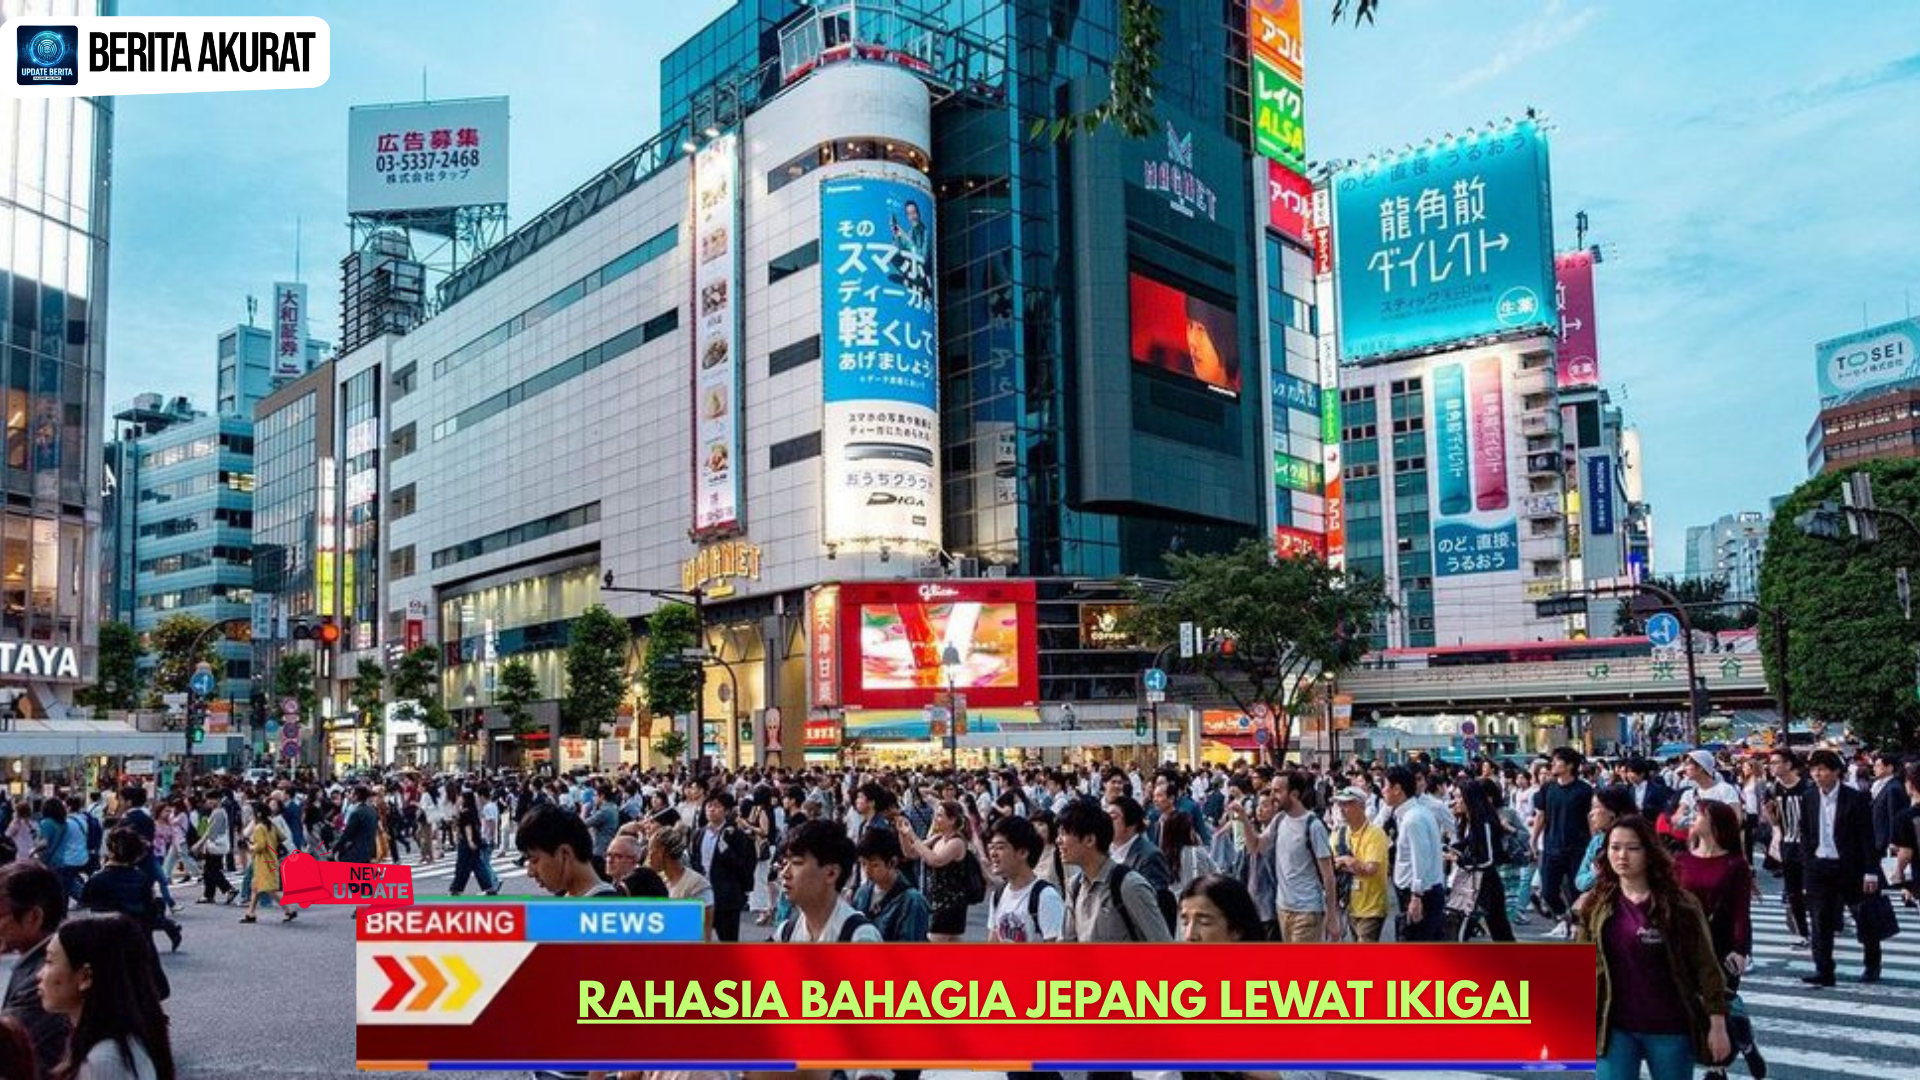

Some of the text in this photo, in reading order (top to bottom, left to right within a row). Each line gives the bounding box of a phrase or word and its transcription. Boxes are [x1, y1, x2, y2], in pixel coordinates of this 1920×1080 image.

[1258, 70, 1300, 119] レイク
[1258, 106, 1302, 149] ALSA
[378, 128, 480, 152] 広告募集
[376, 149, 480, 173] 03-5337-2468
[1380, 175, 1486, 242] 龍角散
[838, 219, 876, 237] その
[1367, 228, 1510, 292] ダイレクト
[838, 306, 933, 355] 軽くして
[1438, 531, 1516, 553] のど、直接、
[1446, 551, 1506, 572] うるおう
[1587, 663, 1610, 679] JR
